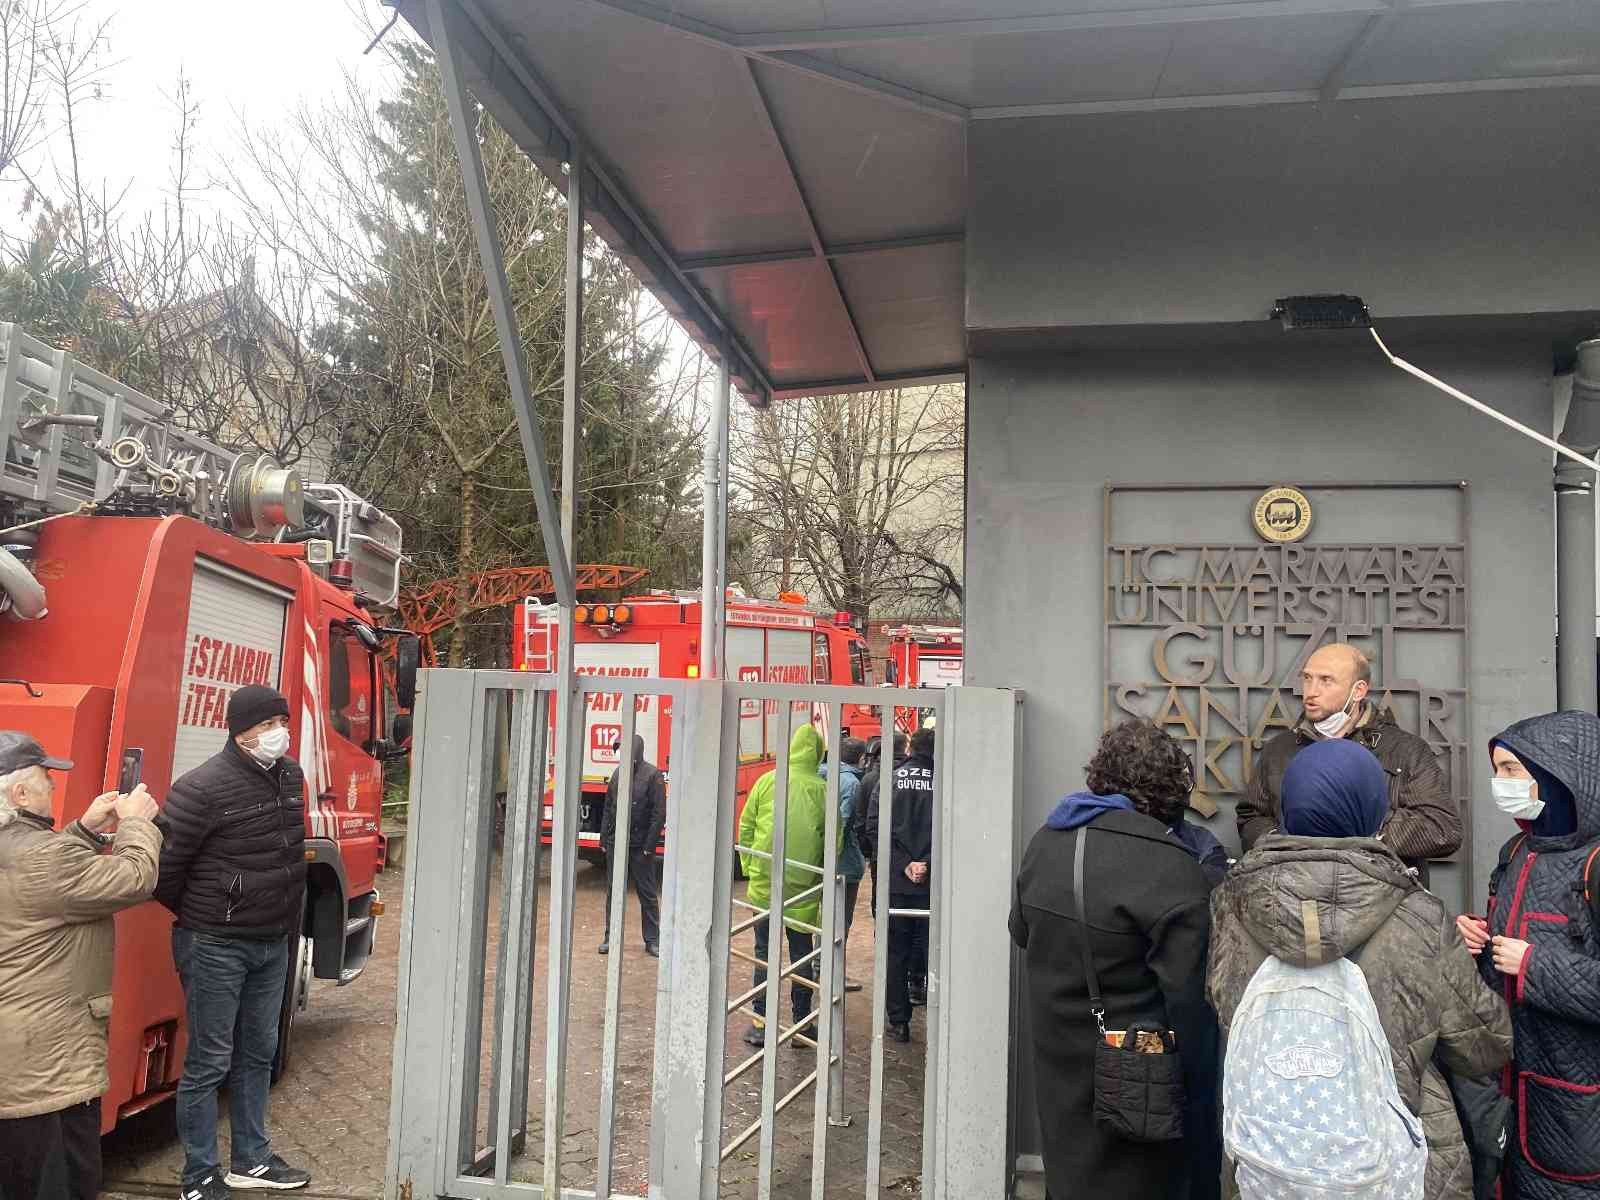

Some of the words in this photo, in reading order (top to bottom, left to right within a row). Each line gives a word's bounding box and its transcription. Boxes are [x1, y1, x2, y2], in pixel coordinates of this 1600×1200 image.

[1199, 544, 1463, 584] MARMARA
[595, 727, 620, 746] 112
[897, 777, 934, 791] GÜVENL
